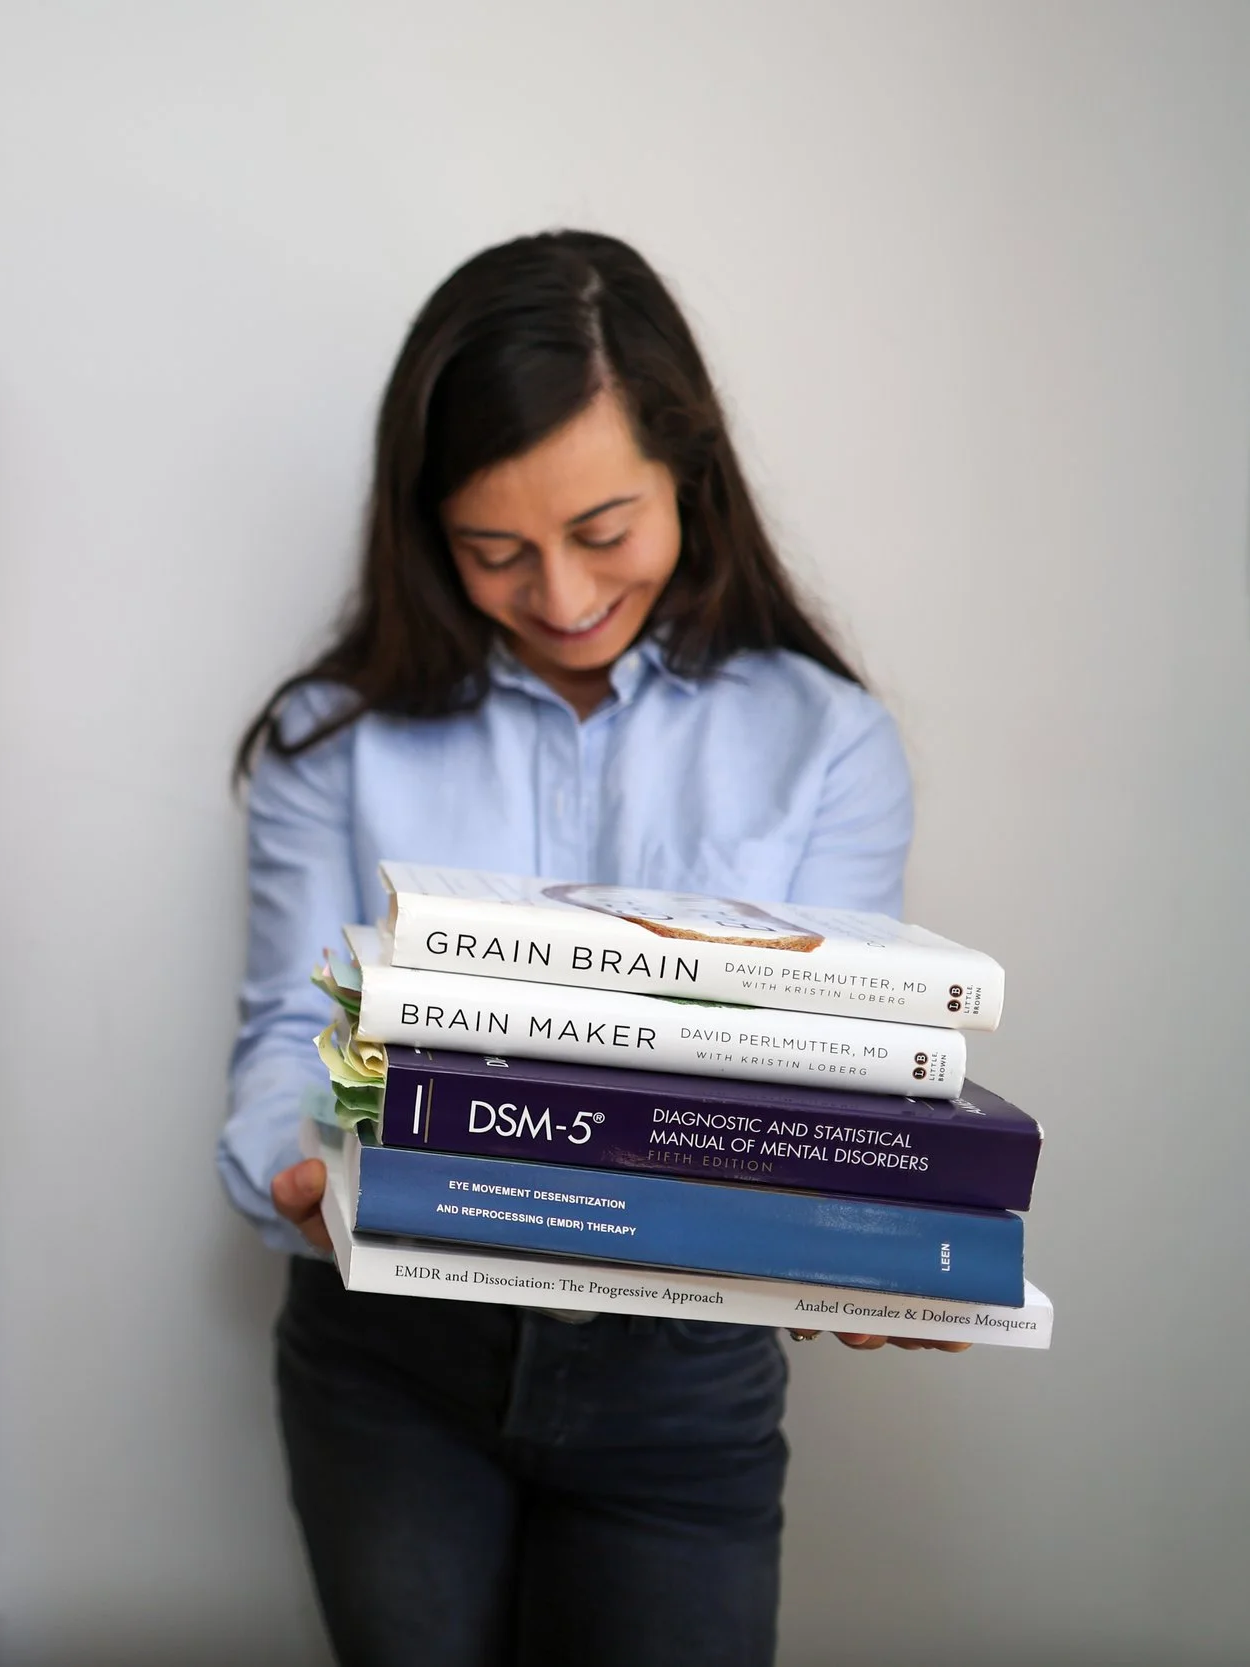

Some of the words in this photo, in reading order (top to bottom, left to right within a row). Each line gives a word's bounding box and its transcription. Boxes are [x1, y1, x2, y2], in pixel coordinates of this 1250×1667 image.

[426, 931, 551, 966] GRAIN
[572, 946, 698, 982] BRAIN
[725, 962, 774, 977] DAVID
[903, 981, 927, 993] MD
[742, 981, 776, 991] WITH
[784, 985, 841, 998] KRISTIN
[849, 992, 905, 1005] LOBERG
[973, 987, 981, 1014] BROWN
[401, 1003, 508, 1034] BRAIN
[529, 1016, 656, 1049] MAKER
[681, 1028, 731, 1043] DAVID
[863, 1046, 888, 1059] MD
[696, 1051, 732, 1061] WITH
[741, 1056, 800, 1068] KRISTIN
[809, 1063, 867, 1076] LOBERG
[938, 1055, 947, 1082] BROWN
[653, 1108, 762, 1133] DIAGNOSTIC
[767, 1121, 808, 1137] AND
[814, 1125, 911, 1148] STATISTICAL
[648, 1150, 693, 1165] FIFTH
[703, 1156, 772, 1172] EDITION
[649, 1130, 725, 1150] MANUAL
[731, 1138, 755, 1153] OF
[760, 1141, 828, 1161] MENTAL
[834, 1148, 928, 1171] DISORDERS
[449, 1180, 469, 1191] EYE
[472, 1183, 531, 1198] MOVEMENT
[534, 1190, 625, 1209] DESENSITIZATION
[436, 1204, 459, 1214] AND
[462, 1207, 544, 1224] REPROCESSING
[546, 1217, 584, 1231] (EMDR)
[587, 1222, 636, 1236] THERAPY
[941, 1243, 951, 1272] LEEN
[395, 1265, 441, 1280] EMDR
[445, 1271, 468, 1282] and
[473, 1272, 554, 1290] Dissociation:
[559, 1279, 584, 1292] The
[589, 1282, 658, 1299] Progressive
[662, 1288, 723, 1304] Approach
[795, 1299, 839, 1313] Anabel
[843, 1303, 900, 1318] Gonzalez
[904, 1309, 917, 1320] &
[922, 1309, 971, 1324] Dolores
[974, 1314, 1036, 1331] Mosquera
